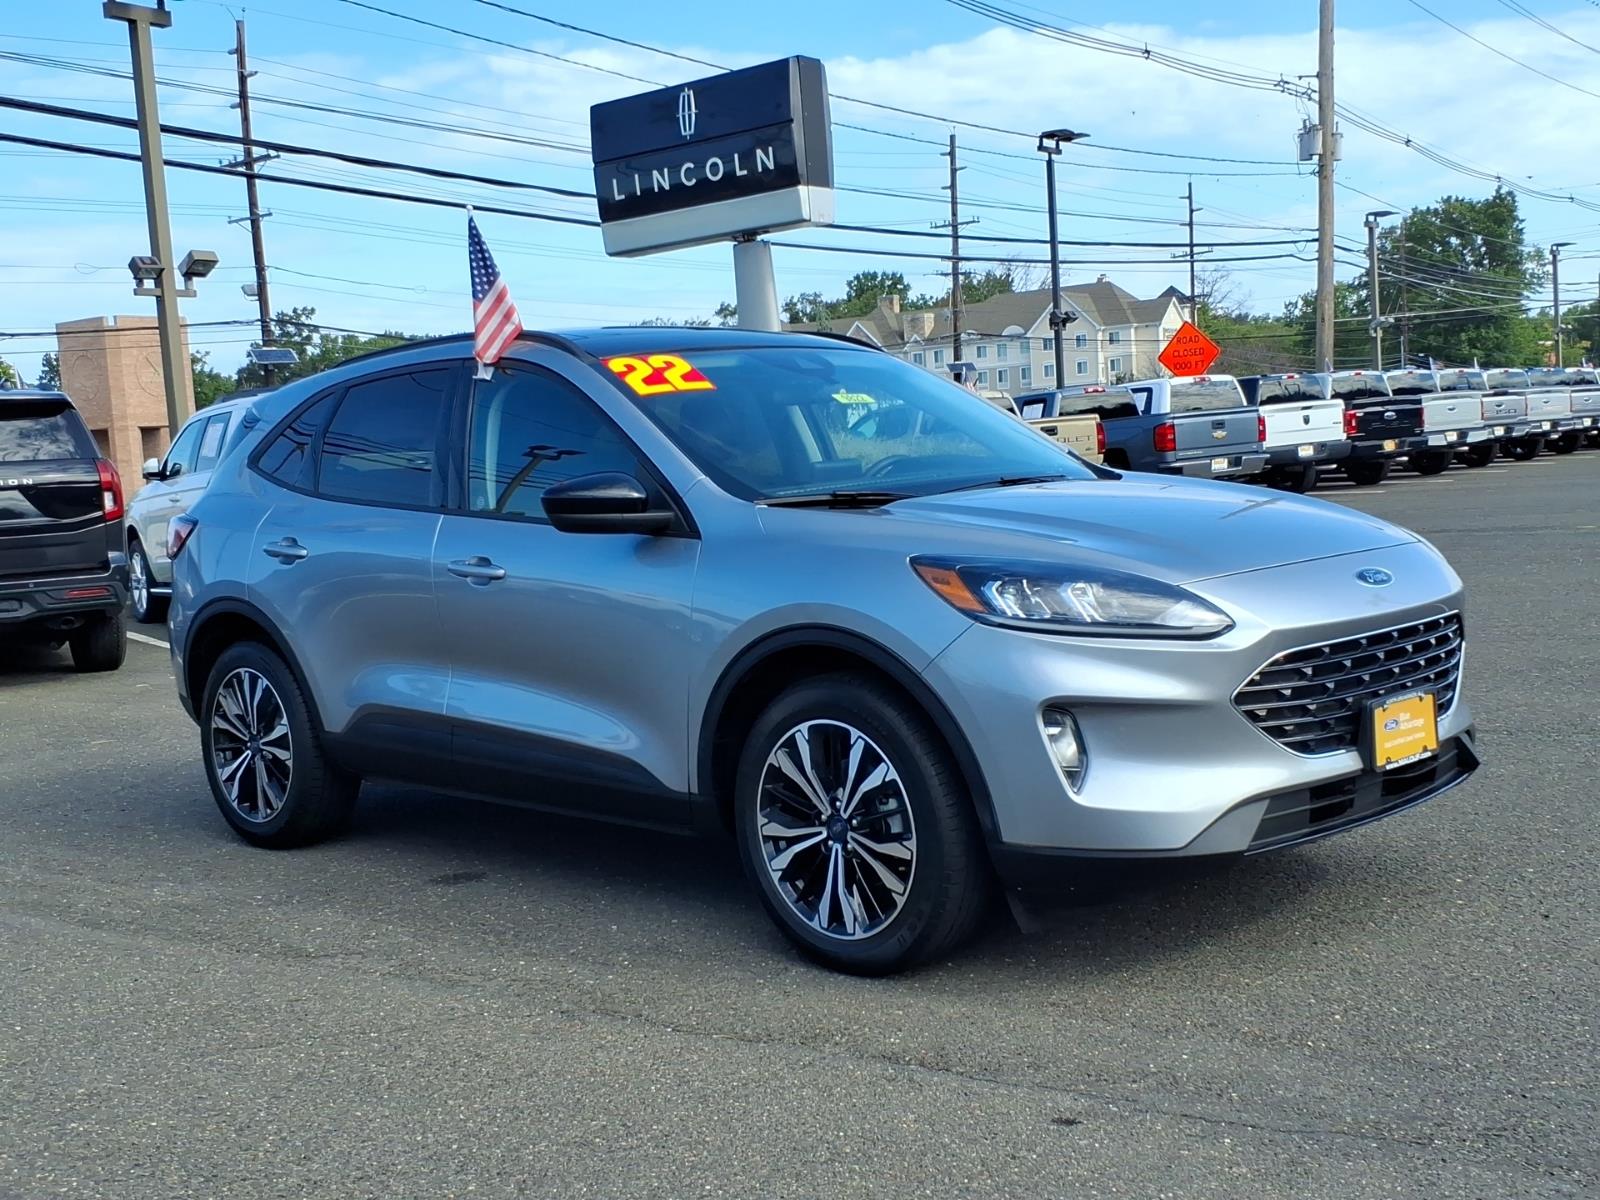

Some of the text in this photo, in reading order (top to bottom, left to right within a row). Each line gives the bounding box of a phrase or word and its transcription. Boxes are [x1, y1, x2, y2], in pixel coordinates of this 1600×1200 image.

[612, 146, 775, 201] LINCOLN
[1176, 335, 1200, 345] ROAD
[1172, 347, 1205, 358] CLOSED
[1173, 359, 1205, 371] 1000 FT
[607, 354, 714, 395] 22
